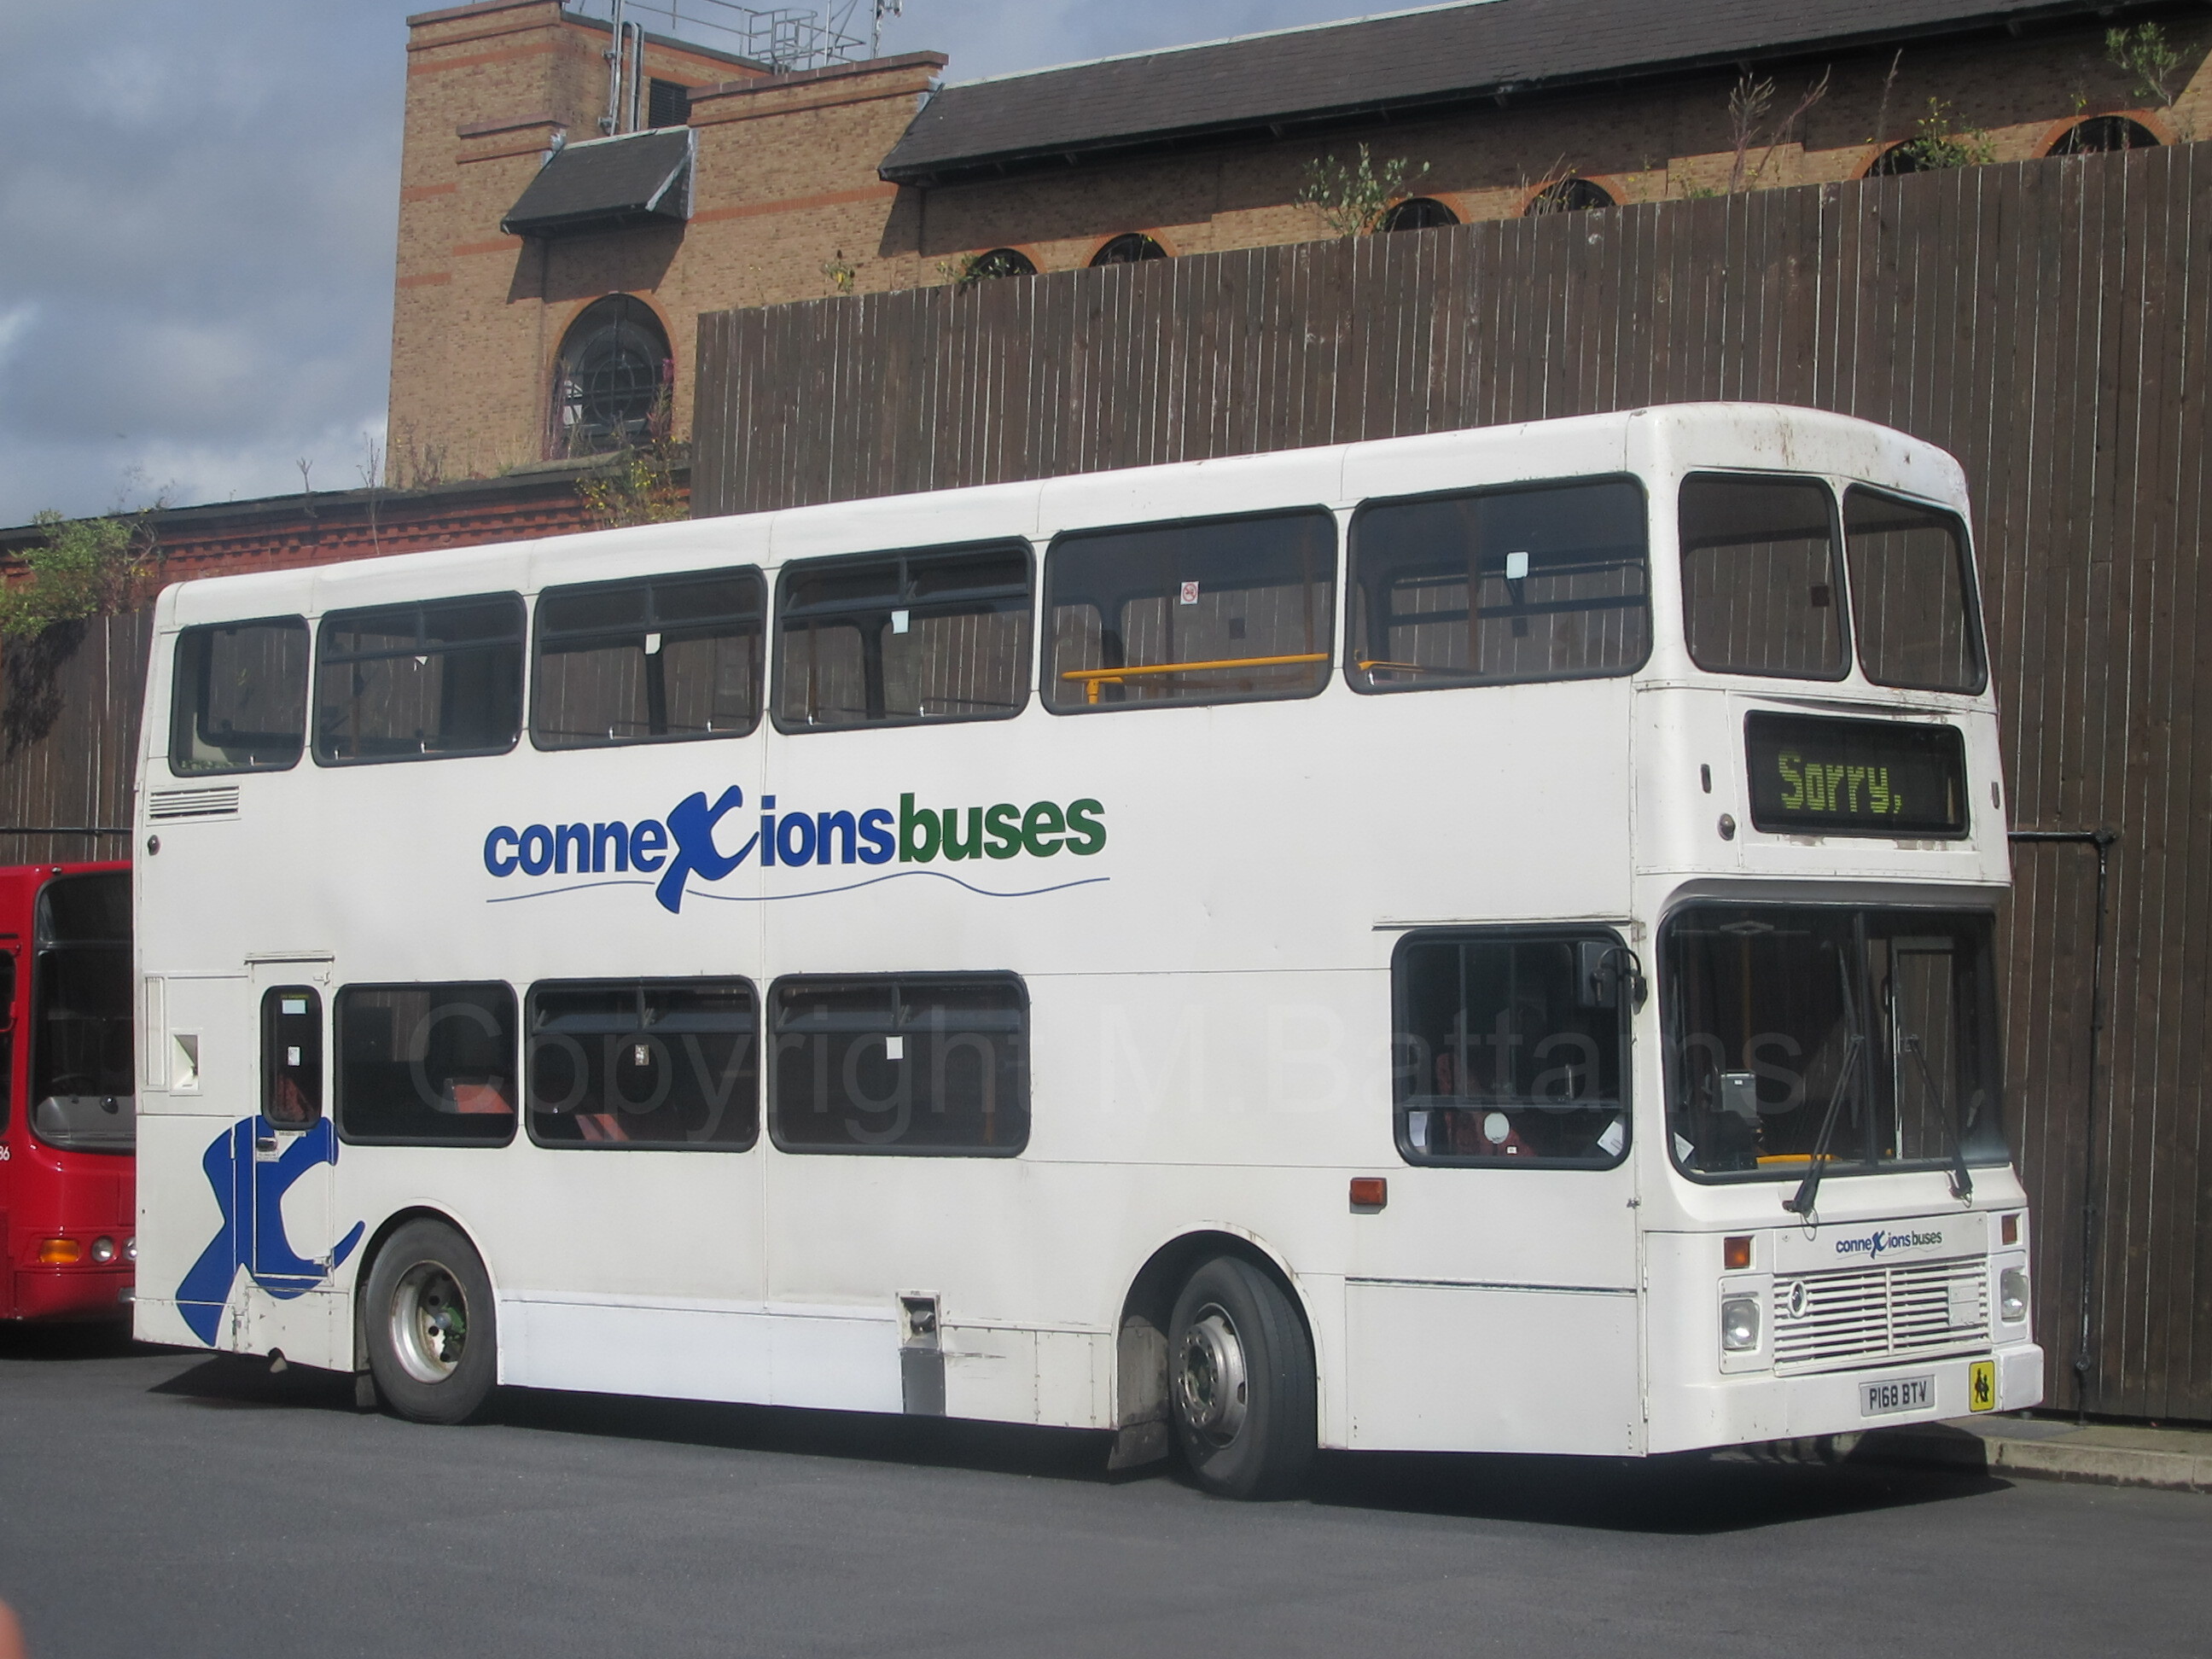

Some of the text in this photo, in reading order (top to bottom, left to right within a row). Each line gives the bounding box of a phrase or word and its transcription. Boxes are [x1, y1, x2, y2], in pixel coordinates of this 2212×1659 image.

[1778, 751, 1903, 815] Sorry,
[1869, 1380, 1927, 1411] P168 BTV
